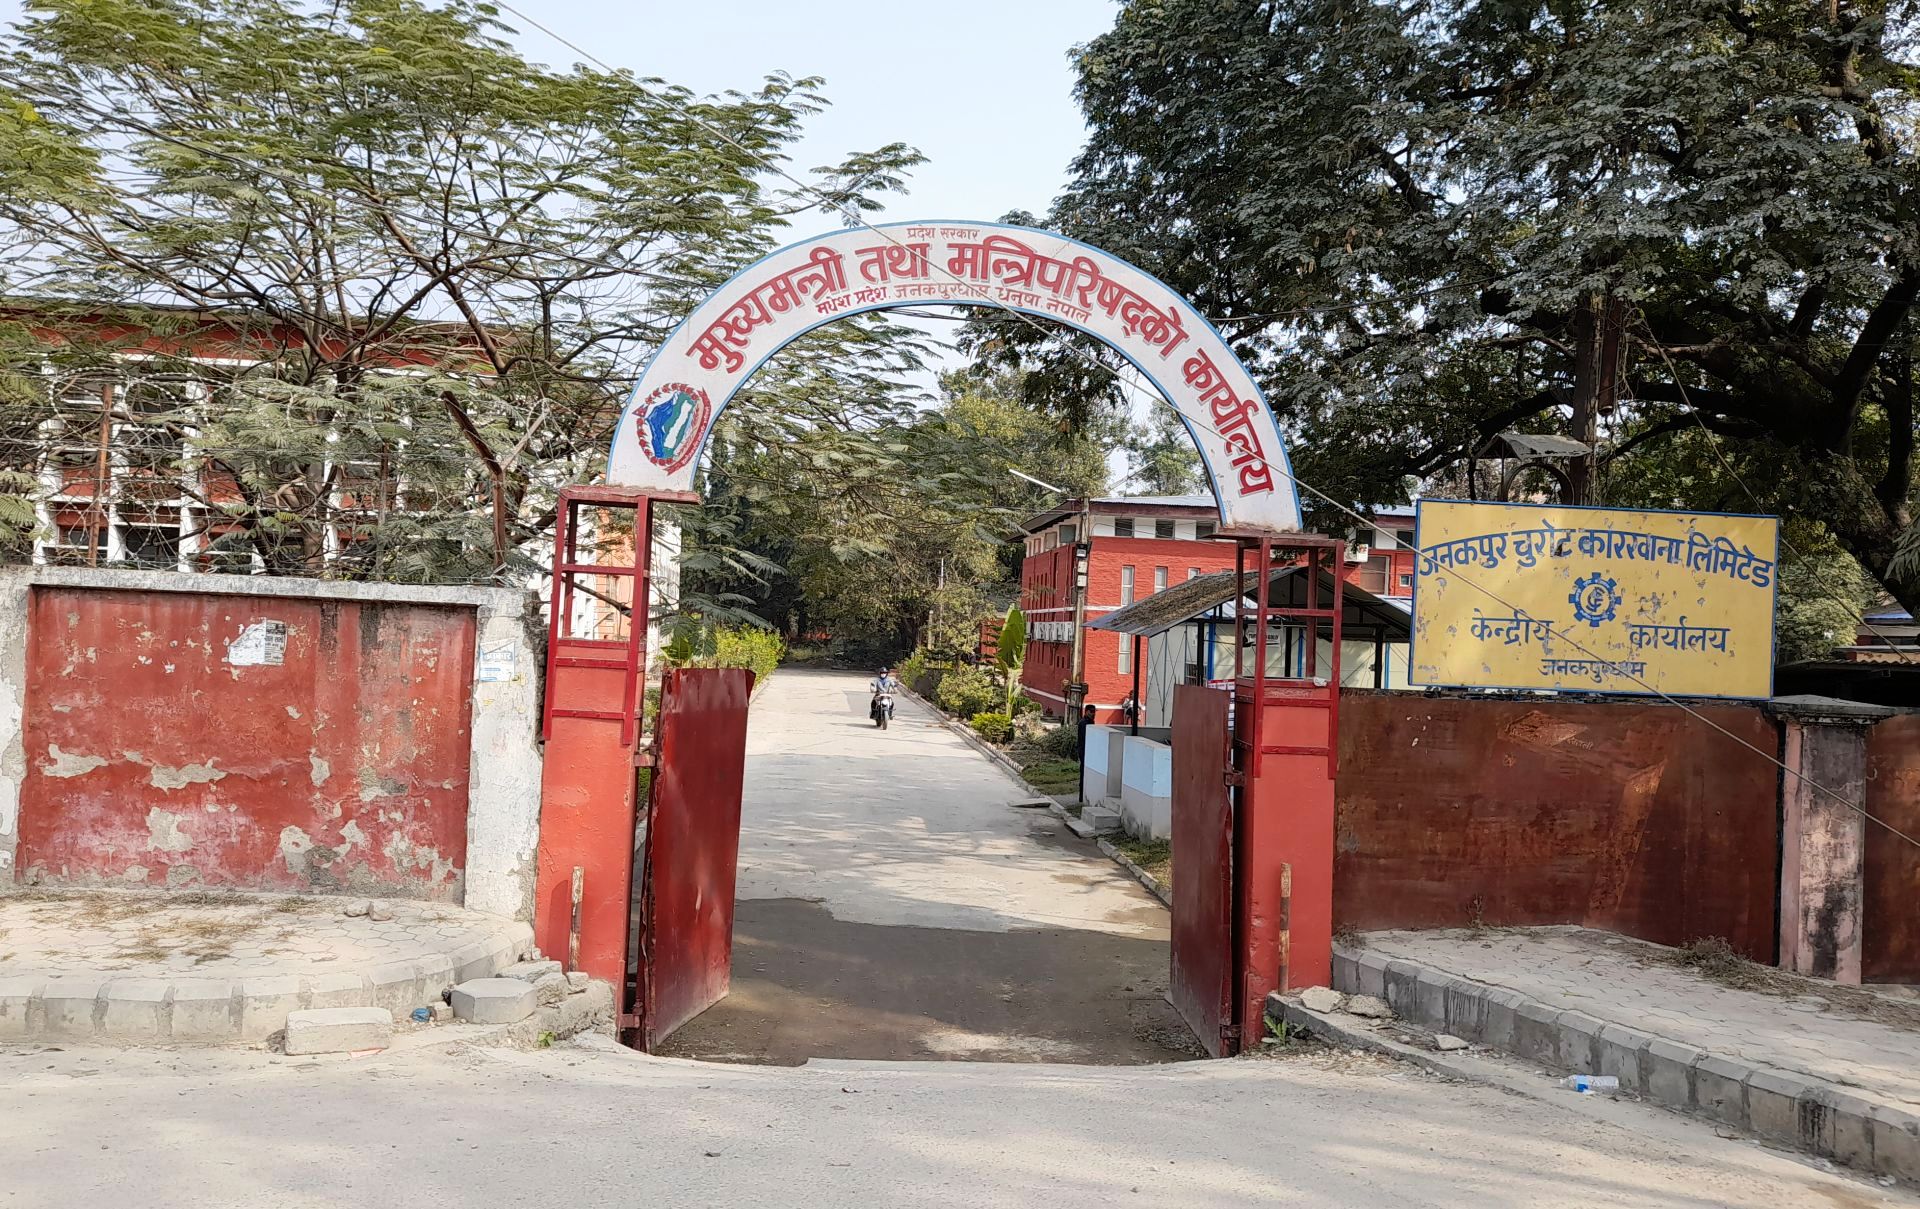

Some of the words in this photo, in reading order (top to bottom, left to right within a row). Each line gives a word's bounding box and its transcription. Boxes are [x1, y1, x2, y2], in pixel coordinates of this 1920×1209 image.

[906, 225, 936, 242] प्रदेश
[940, 227, 980, 241] सरकार
[815, 295, 852, 315] मधेश
[1046, 294, 1092, 324] नेपाल
[686, 246, 847, 374] मुख्यमन्त्री
[854, 242, 931, 284] तथा
[946, 234, 1190, 357] मन्त्रिपरिषद्को
[1183, 347, 1275, 496] कार्यालय
[1418, 532, 1509, 576] जनकपुर
[1510, 518, 1577, 568] चुरोट
[1577, 528, 1686, 565] कारखाना
[1686, 531, 1774, 588] लिमिटेड
[1470, 608, 1555, 647] केन्द्रीय
[1629, 615, 1731, 653] कार्यालय
